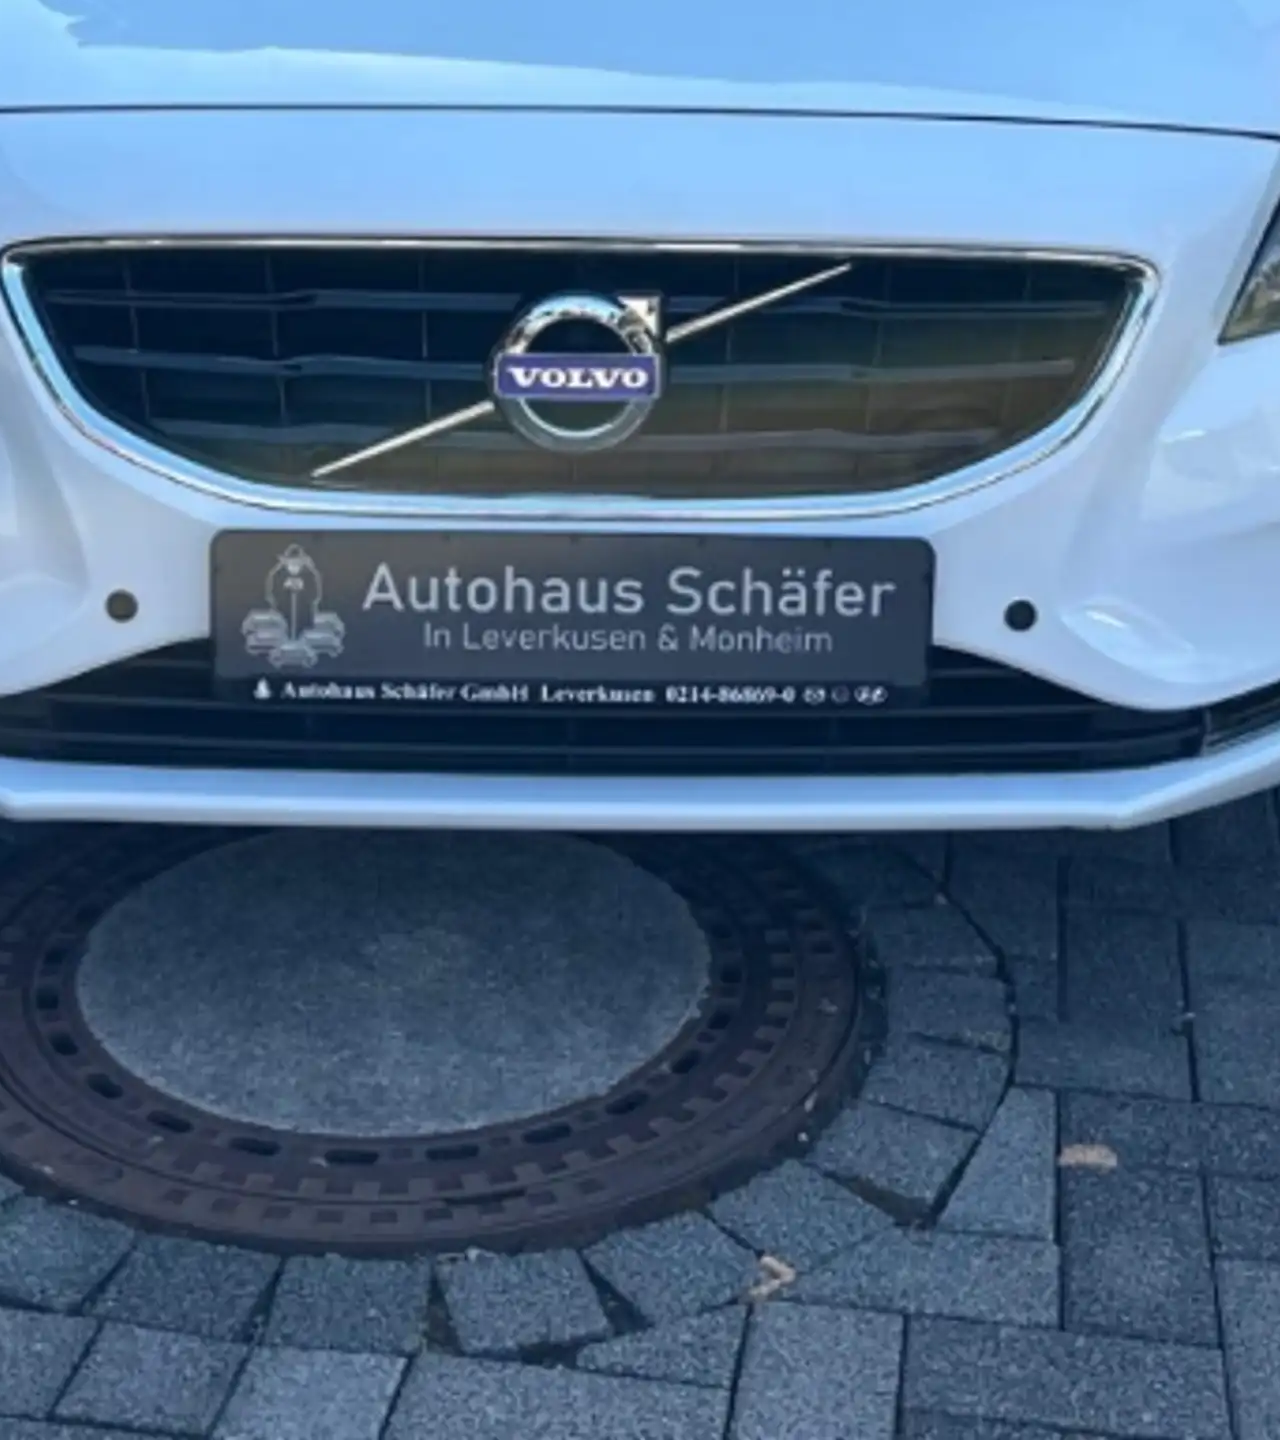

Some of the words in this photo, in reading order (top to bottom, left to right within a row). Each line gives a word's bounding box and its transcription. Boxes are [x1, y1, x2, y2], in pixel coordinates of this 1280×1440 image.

[507, 366, 649, 389] VOLVO
[361, 561, 645, 614] Autohaus
[665, 564, 898, 618] Schäfer
[422, 620, 452, 649] In
[461, 621, 647, 653] Leverkusen
[656, 622, 680, 652] &
[687, 623, 834, 655] Monheim
[280, 680, 376, 701] Autohaus
[380, 680, 458, 702] Schäfer
[460, 681, 530, 704] GmbH
[540, 682, 657, 704] Leverkusen
